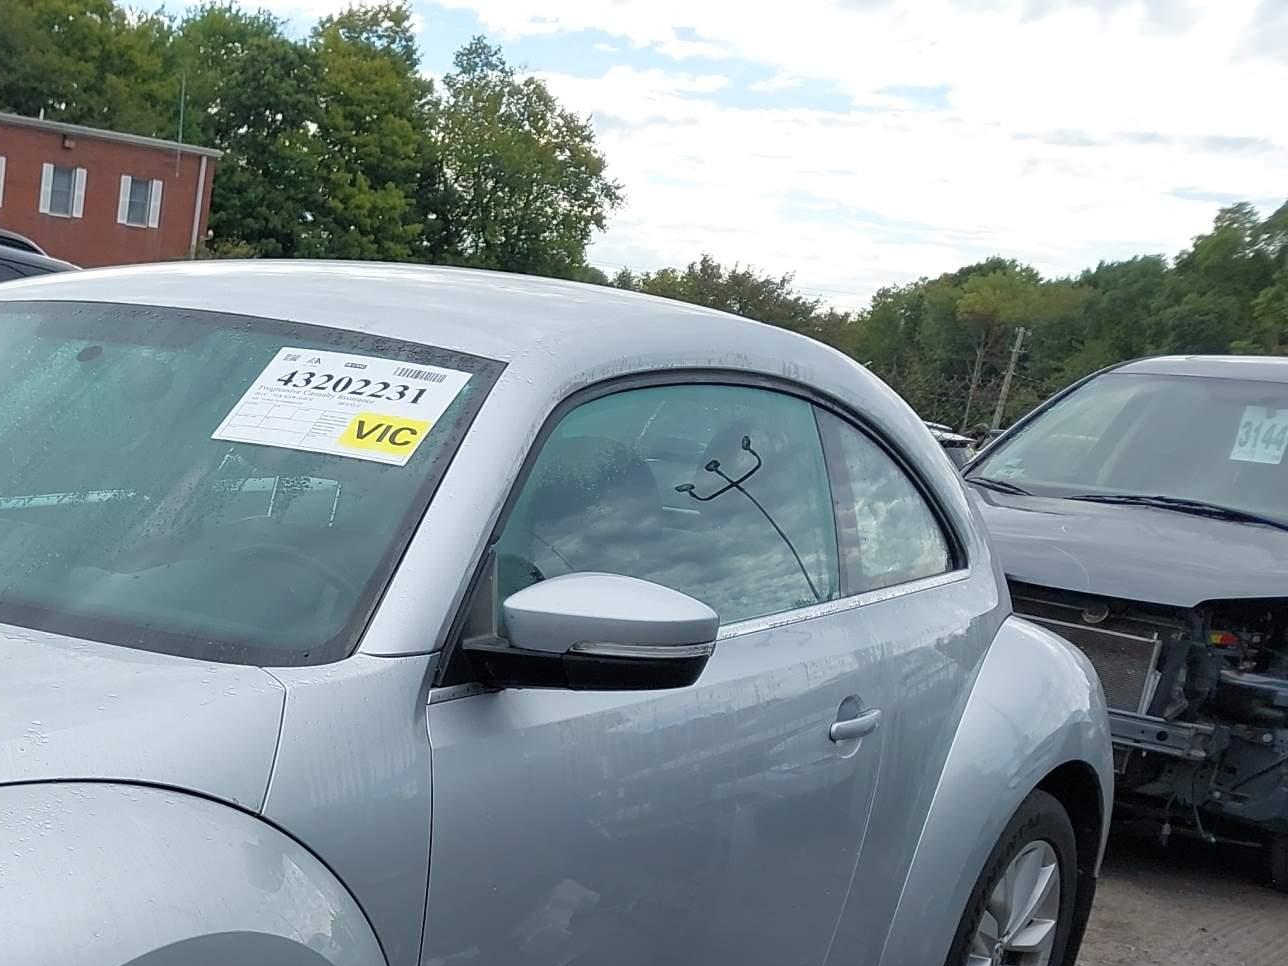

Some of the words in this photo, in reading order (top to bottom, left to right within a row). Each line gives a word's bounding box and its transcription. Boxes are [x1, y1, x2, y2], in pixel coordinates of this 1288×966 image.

[258, 384, 303, 395] Progressive
[303, 389, 335, 400] Casualty
[337, 394, 376, 404] Insurance
[277, 369, 427, 405] 43202231
[355, 420, 418, 446] VIC
[1238, 420, 1288, 451] 3144
